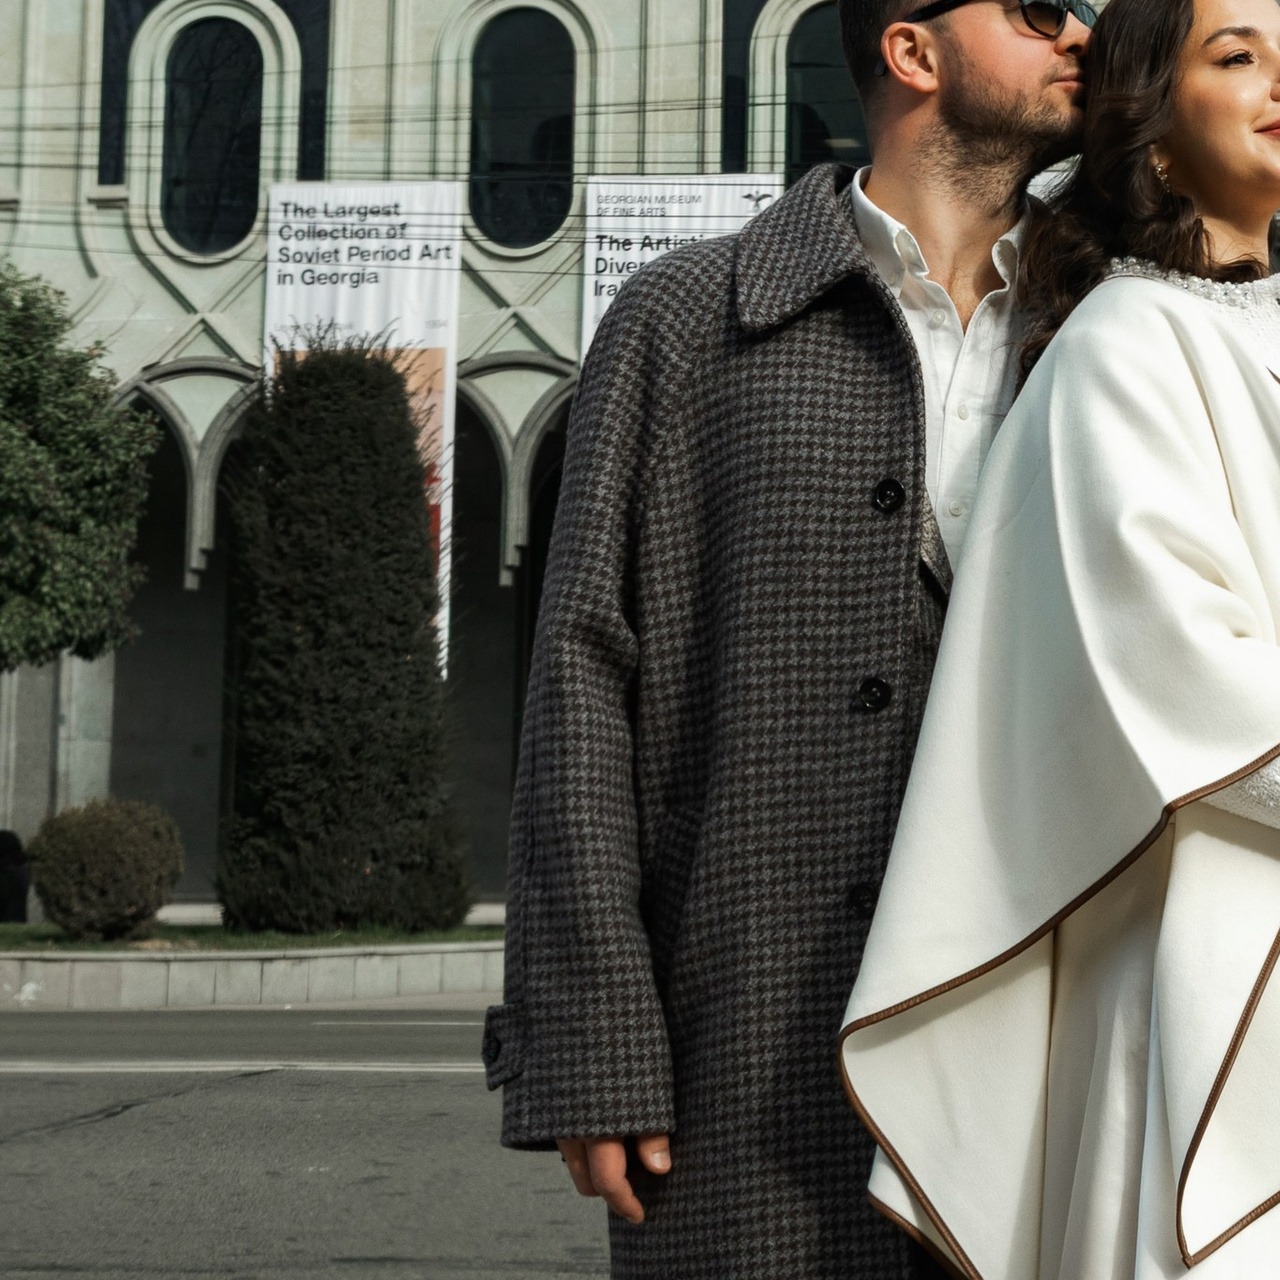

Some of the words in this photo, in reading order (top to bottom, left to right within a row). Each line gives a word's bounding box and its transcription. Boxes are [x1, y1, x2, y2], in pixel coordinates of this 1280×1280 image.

[596, 195, 652, 205] GEORGIAN
[654, 195, 702, 205] MUSEUM
[280, 202, 317, 218] The
[323, 202, 401, 221] Largest
[596, 207, 610, 217] OF
[613, 207, 636, 217] FINE
[639, 207, 667, 217] ARTS
[279, 223, 379, 241] Collection
[386, 222, 407, 240] of
[595, 235, 632, 251] The
[278, 246, 340, 264] Soviet
[347, 244, 411, 262] Period
[419, 244, 453, 262] Art
[277, 269, 294, 286] in
[301, 268, 379, 288] Georgia
[594, 279, 624, 297] Ira
